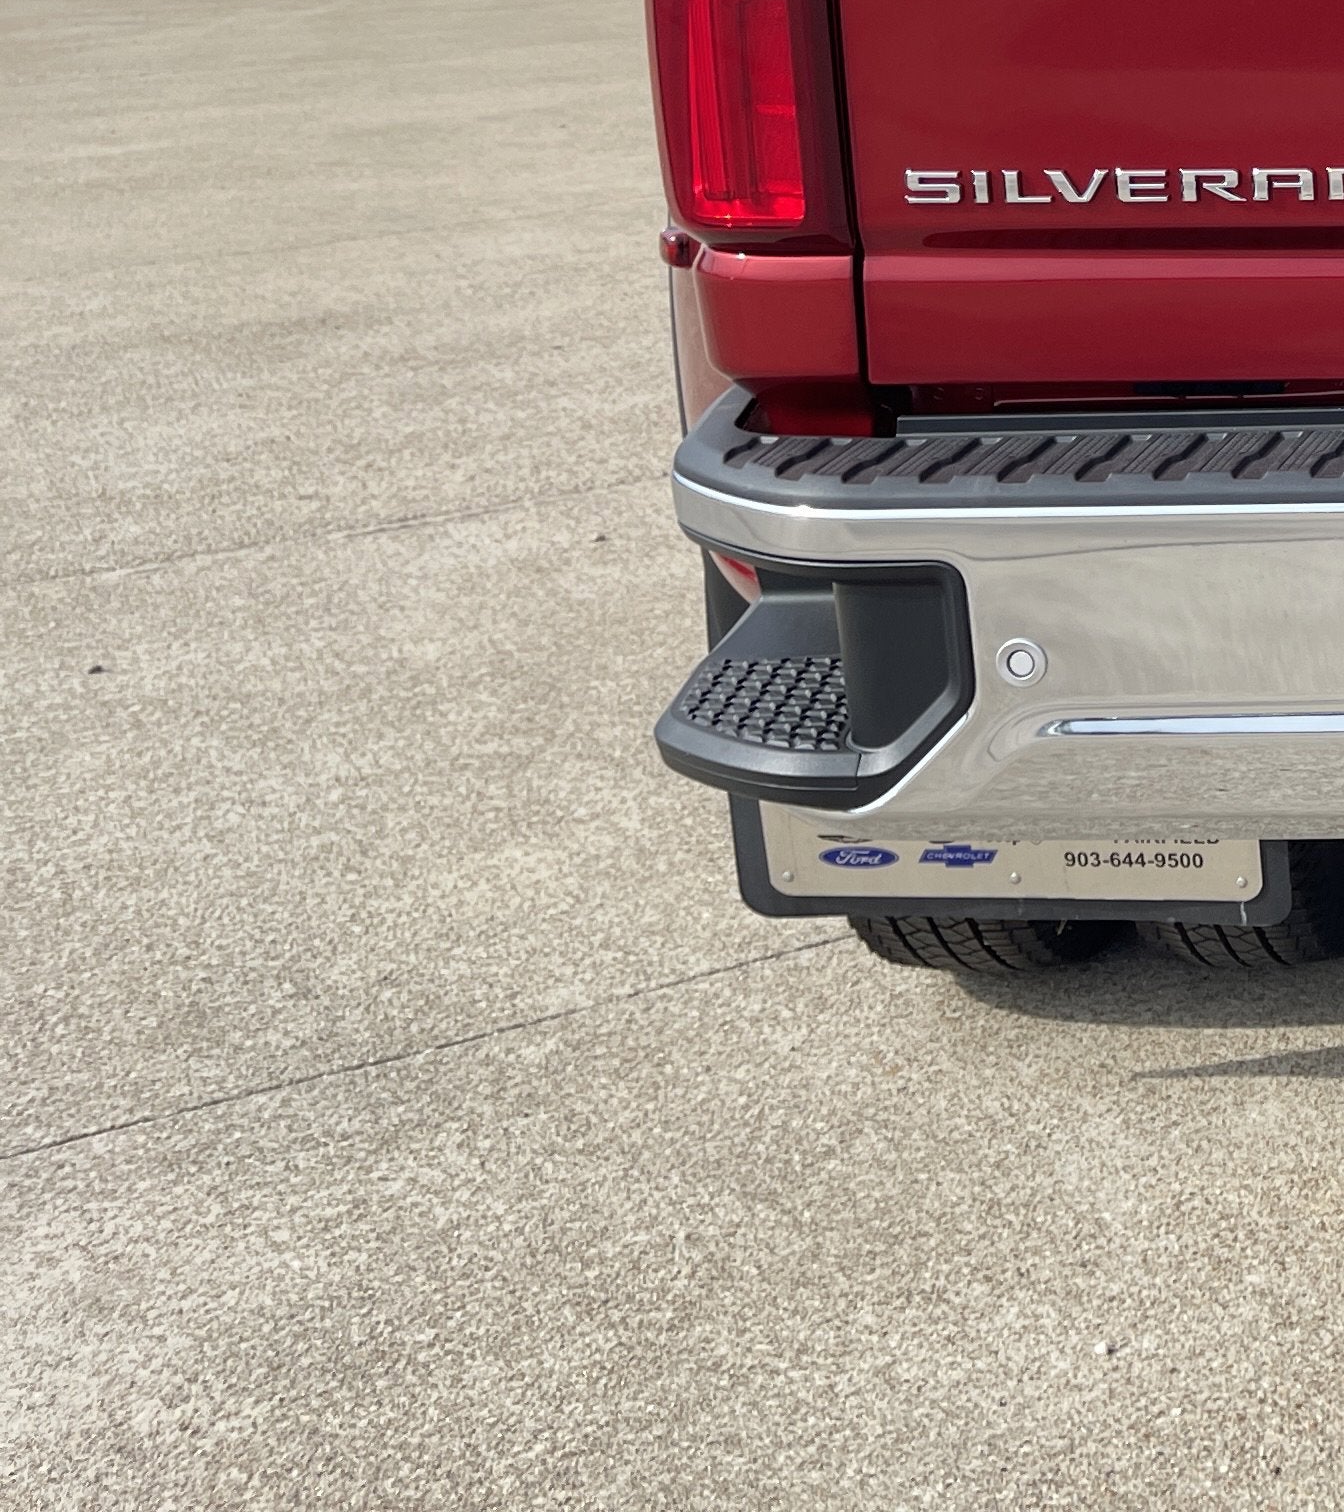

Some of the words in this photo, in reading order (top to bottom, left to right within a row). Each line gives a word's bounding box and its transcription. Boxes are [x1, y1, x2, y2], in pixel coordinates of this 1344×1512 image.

[835, 849, 882, 865] Ford
[926, 852, 990, 860] CHEVROLET
[1064, 851, 1204, 869] 903-644-9500
